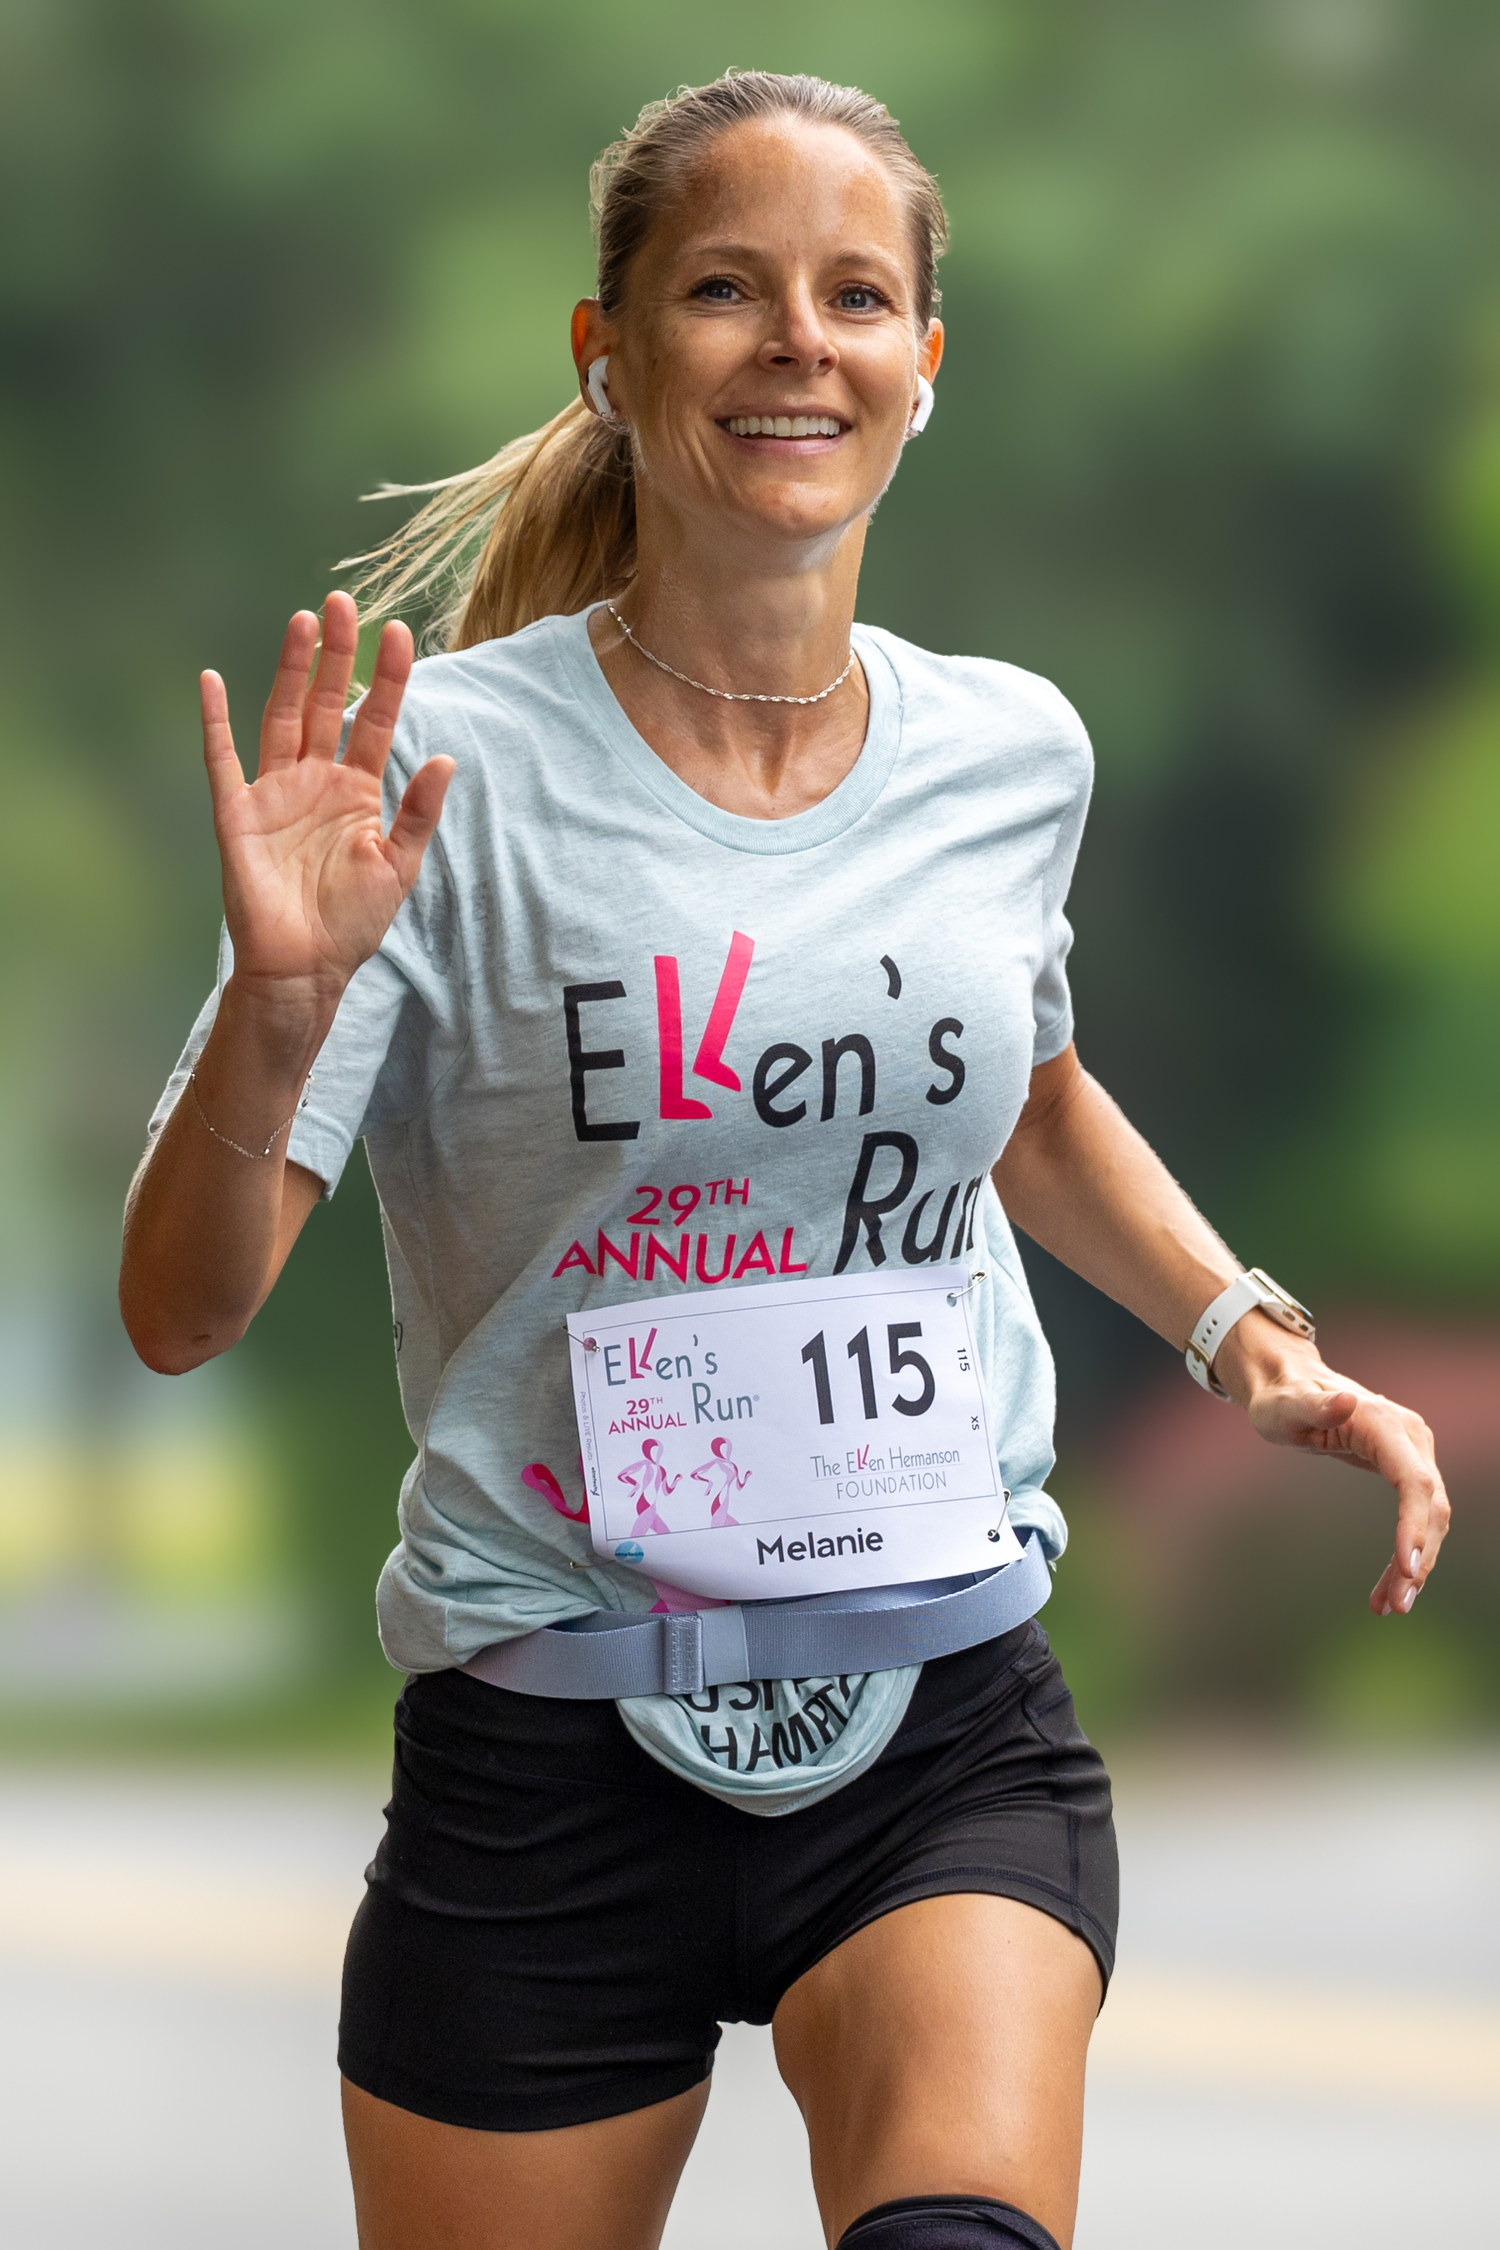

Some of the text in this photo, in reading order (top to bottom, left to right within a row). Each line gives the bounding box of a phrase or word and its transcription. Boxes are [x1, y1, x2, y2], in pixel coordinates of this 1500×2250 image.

[627, 1178, 750, 1226] 29TH
[833, 1131, 986, 1275] Run
[551, 1227, 807, 1284] ANNUAL
[801, 1321, 936, 1425] 115
[957, 1347, 971, 1372] 115
[608, 1411, 687, 1435] ANNUAL
[626, 1397, 663, 1415] 29TH
[970, 1415, 980, 1431] XS
[580, 1391, 589, 1413] Photos
[585, 1438, 593, 1461] Results
[810, 1455, 841, 1477] The
[889, 1446, 960, 1469] Hermanson
[836, 1470, 947, 1499] FOUNDATION
[756, 1528, 884, 1565] Melanie
